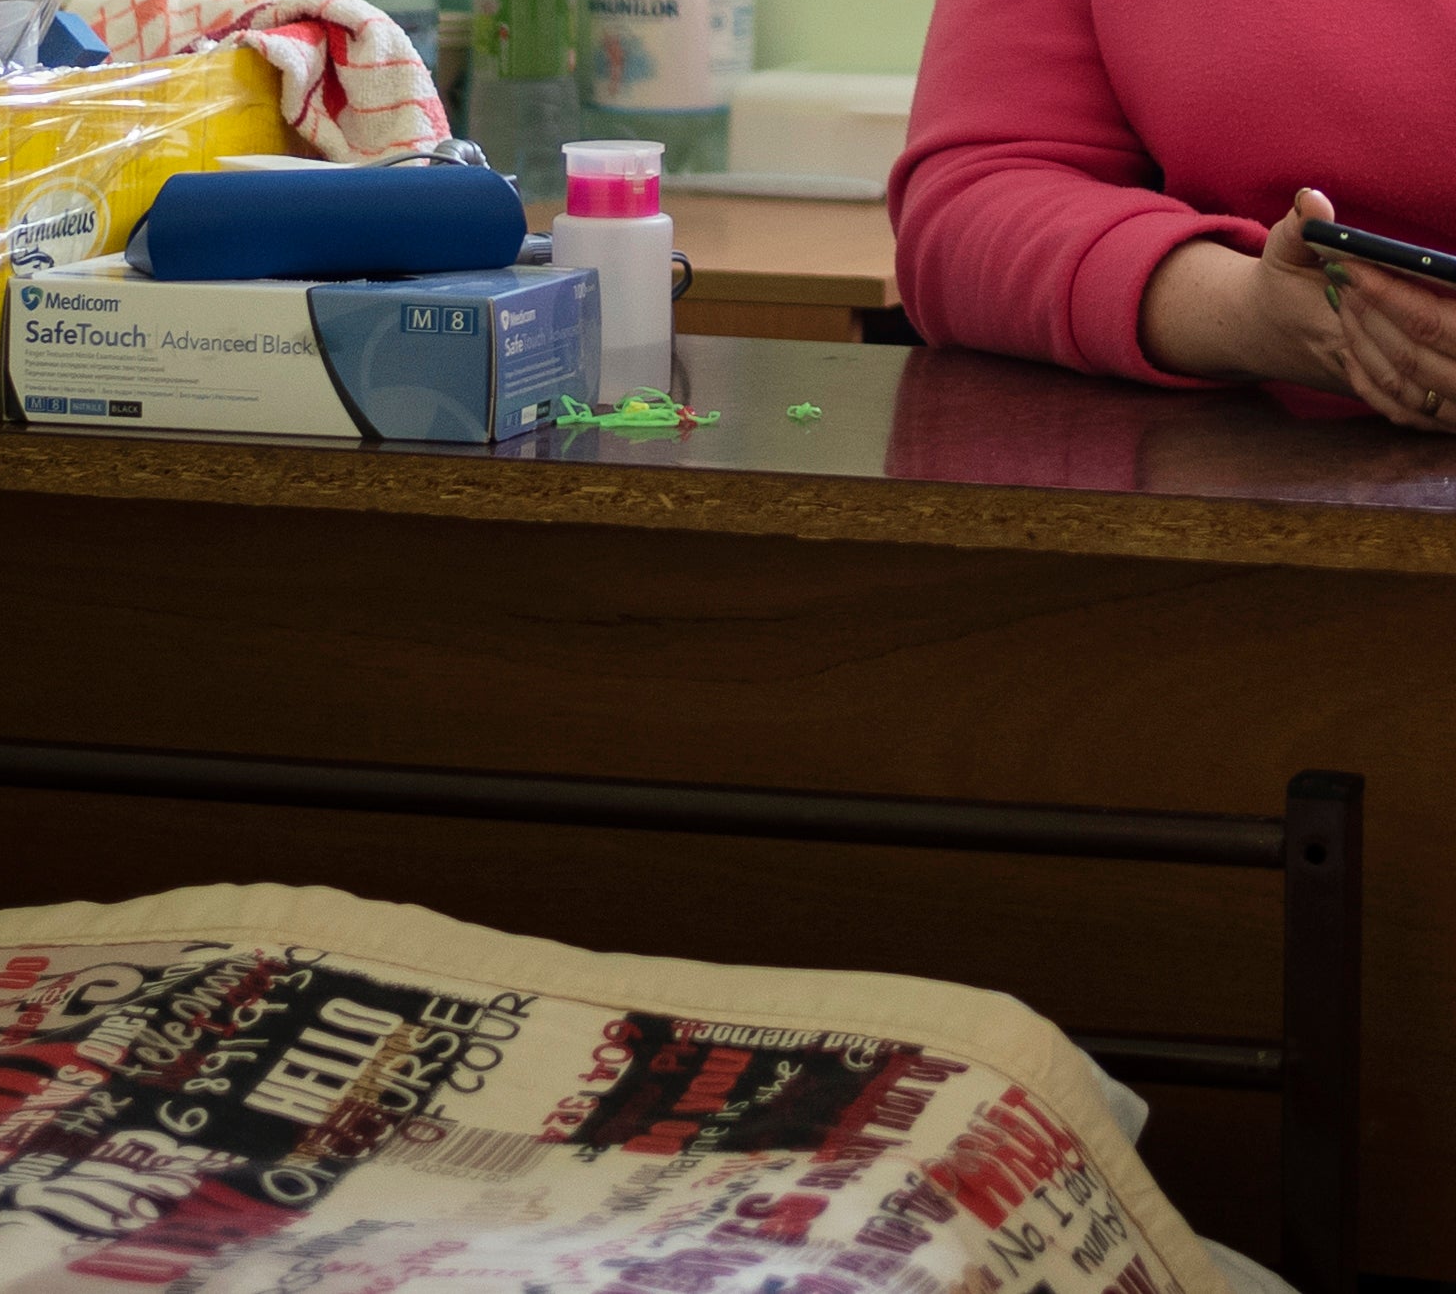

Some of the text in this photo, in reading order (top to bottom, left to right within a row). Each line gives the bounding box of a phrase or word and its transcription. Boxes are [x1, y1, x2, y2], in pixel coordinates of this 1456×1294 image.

[16, 208, 96, 244] Amadeus
[45, 292, 119, 312] Medicom
[412, 309, 464, 330] M 8
[25, 320, 312, 355] SafeTouch Advanced Black
[30, 398, 42, 409] M
[51, 399, 59, 410] 8
[111, 405, 139, 413] BLACK
[244, 996, 405, 1125] HELLO
[51, 1091, 132, 1139] the
